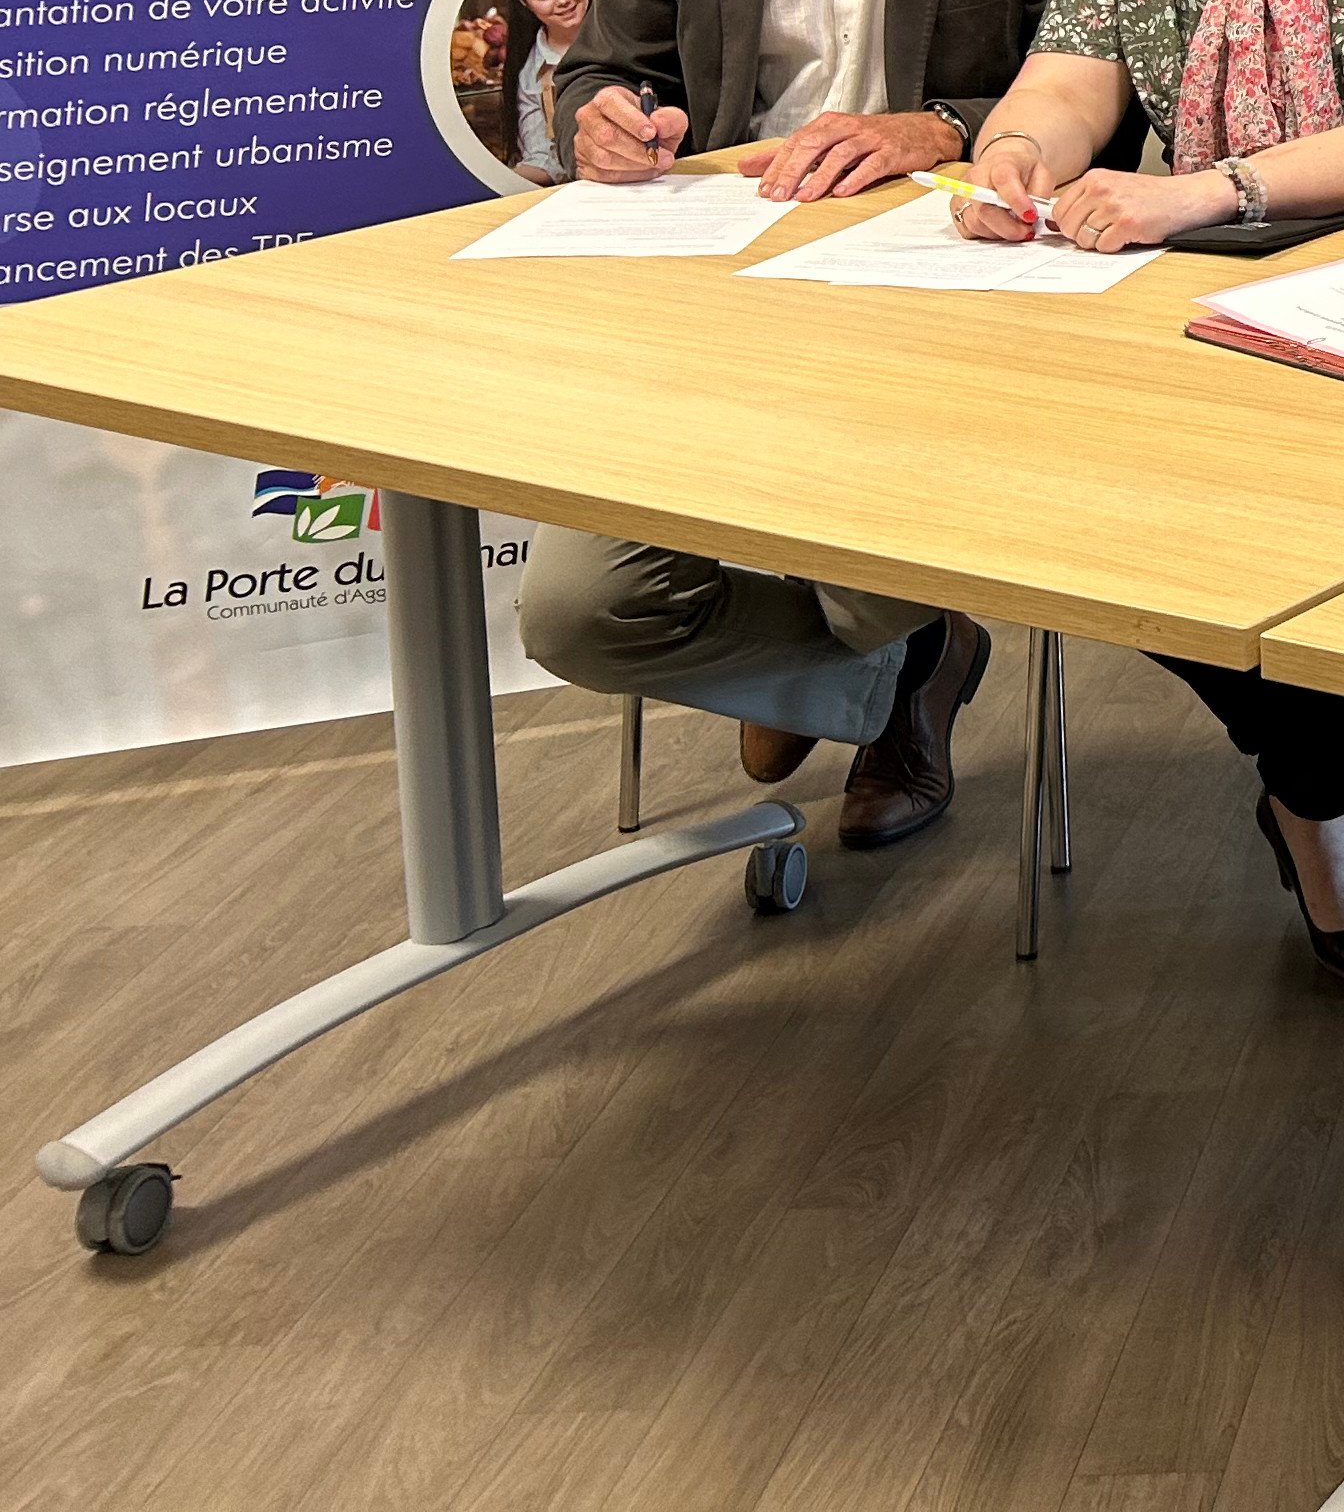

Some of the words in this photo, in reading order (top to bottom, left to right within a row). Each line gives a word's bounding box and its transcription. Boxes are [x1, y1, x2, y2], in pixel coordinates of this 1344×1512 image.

[0, 50, 89, 79] sition
[104, 39, 287, 73] numérique
[144, 86, 383, 127] réglementaire
[0, 144, 204, 186] seignement
[216, 135, 393, 168] urbanisme
[3, 211, 55, 233] rse
[68, 205, 132, 228] aux
[144, 192, 258, 222] locaux
[142, 577, 188, 610] La
[205, 563, 320, 603] Porte
[333, 551, 385, 586] du
[206, 591, 329, 621] Communauté
